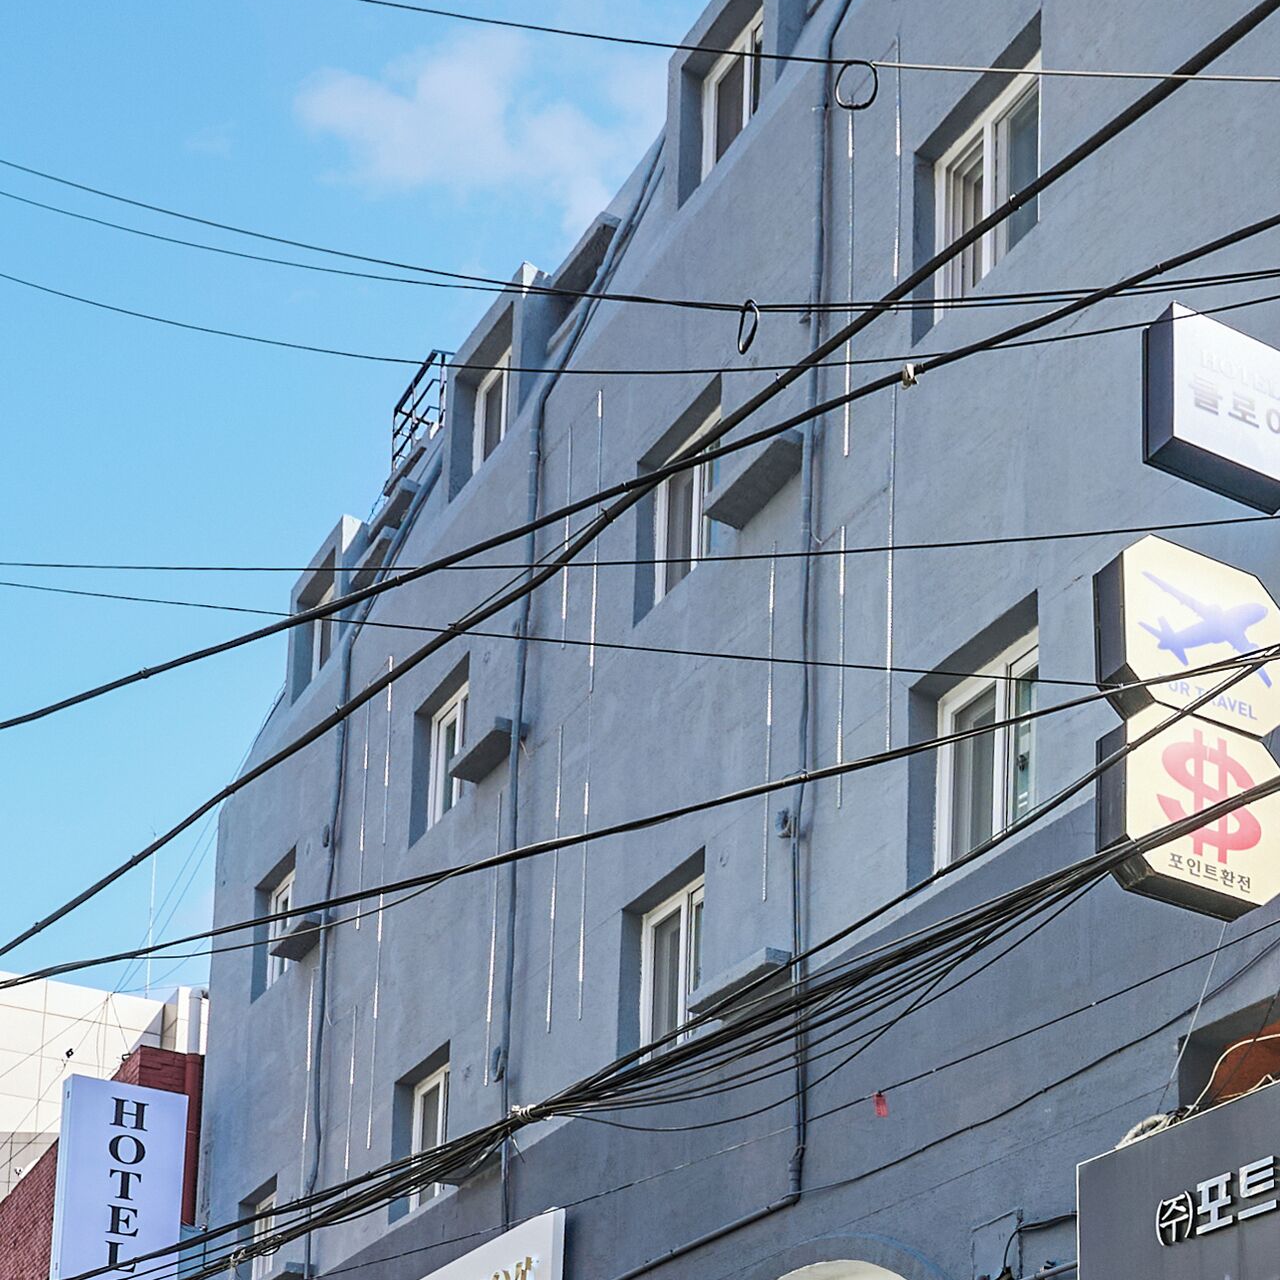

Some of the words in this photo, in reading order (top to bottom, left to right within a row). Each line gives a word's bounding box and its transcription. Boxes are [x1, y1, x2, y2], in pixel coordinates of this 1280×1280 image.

[1195, 686, 1258, 720] TAVEL
[1167, 851, 1251, 894] 포인트환전
[107, 1097, 149, 1274] HOTEL
